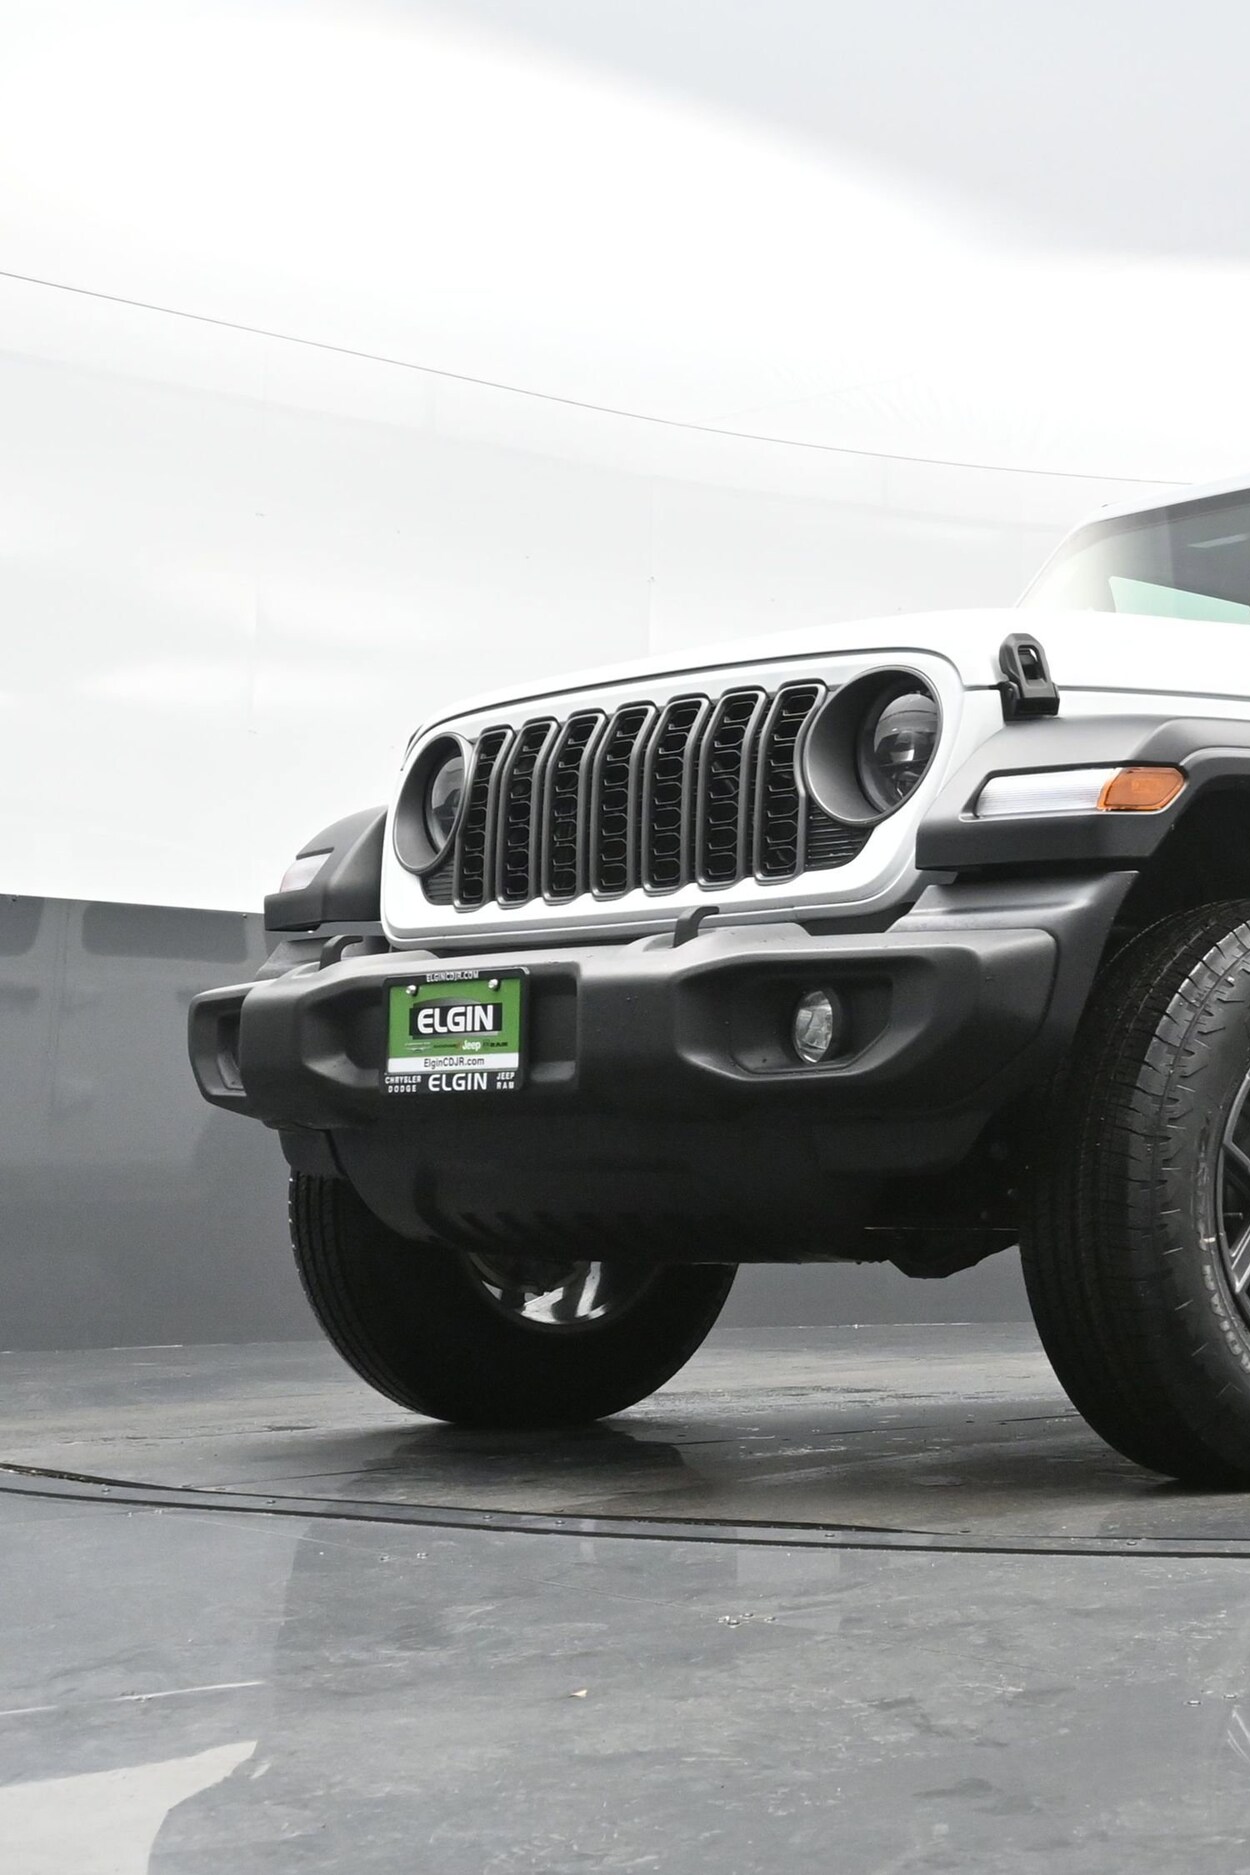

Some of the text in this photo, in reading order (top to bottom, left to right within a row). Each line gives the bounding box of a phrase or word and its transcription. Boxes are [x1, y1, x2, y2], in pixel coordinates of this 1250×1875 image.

[417, 1004, 494, 1034] ELGIN
[462, 1039, 481, 1052] Jeep
[424, 1057, 485, 1069] ElginCDJR.com
[385, 1075, 422, 1084] CHRYSLER
[496, 1071, 515, 1080] JEEP
[428, 1072, 488, 1092] ELGIN
[496, 1081, 515, 1090] RAM
[388, 1084, 417, 1094] DODGE
